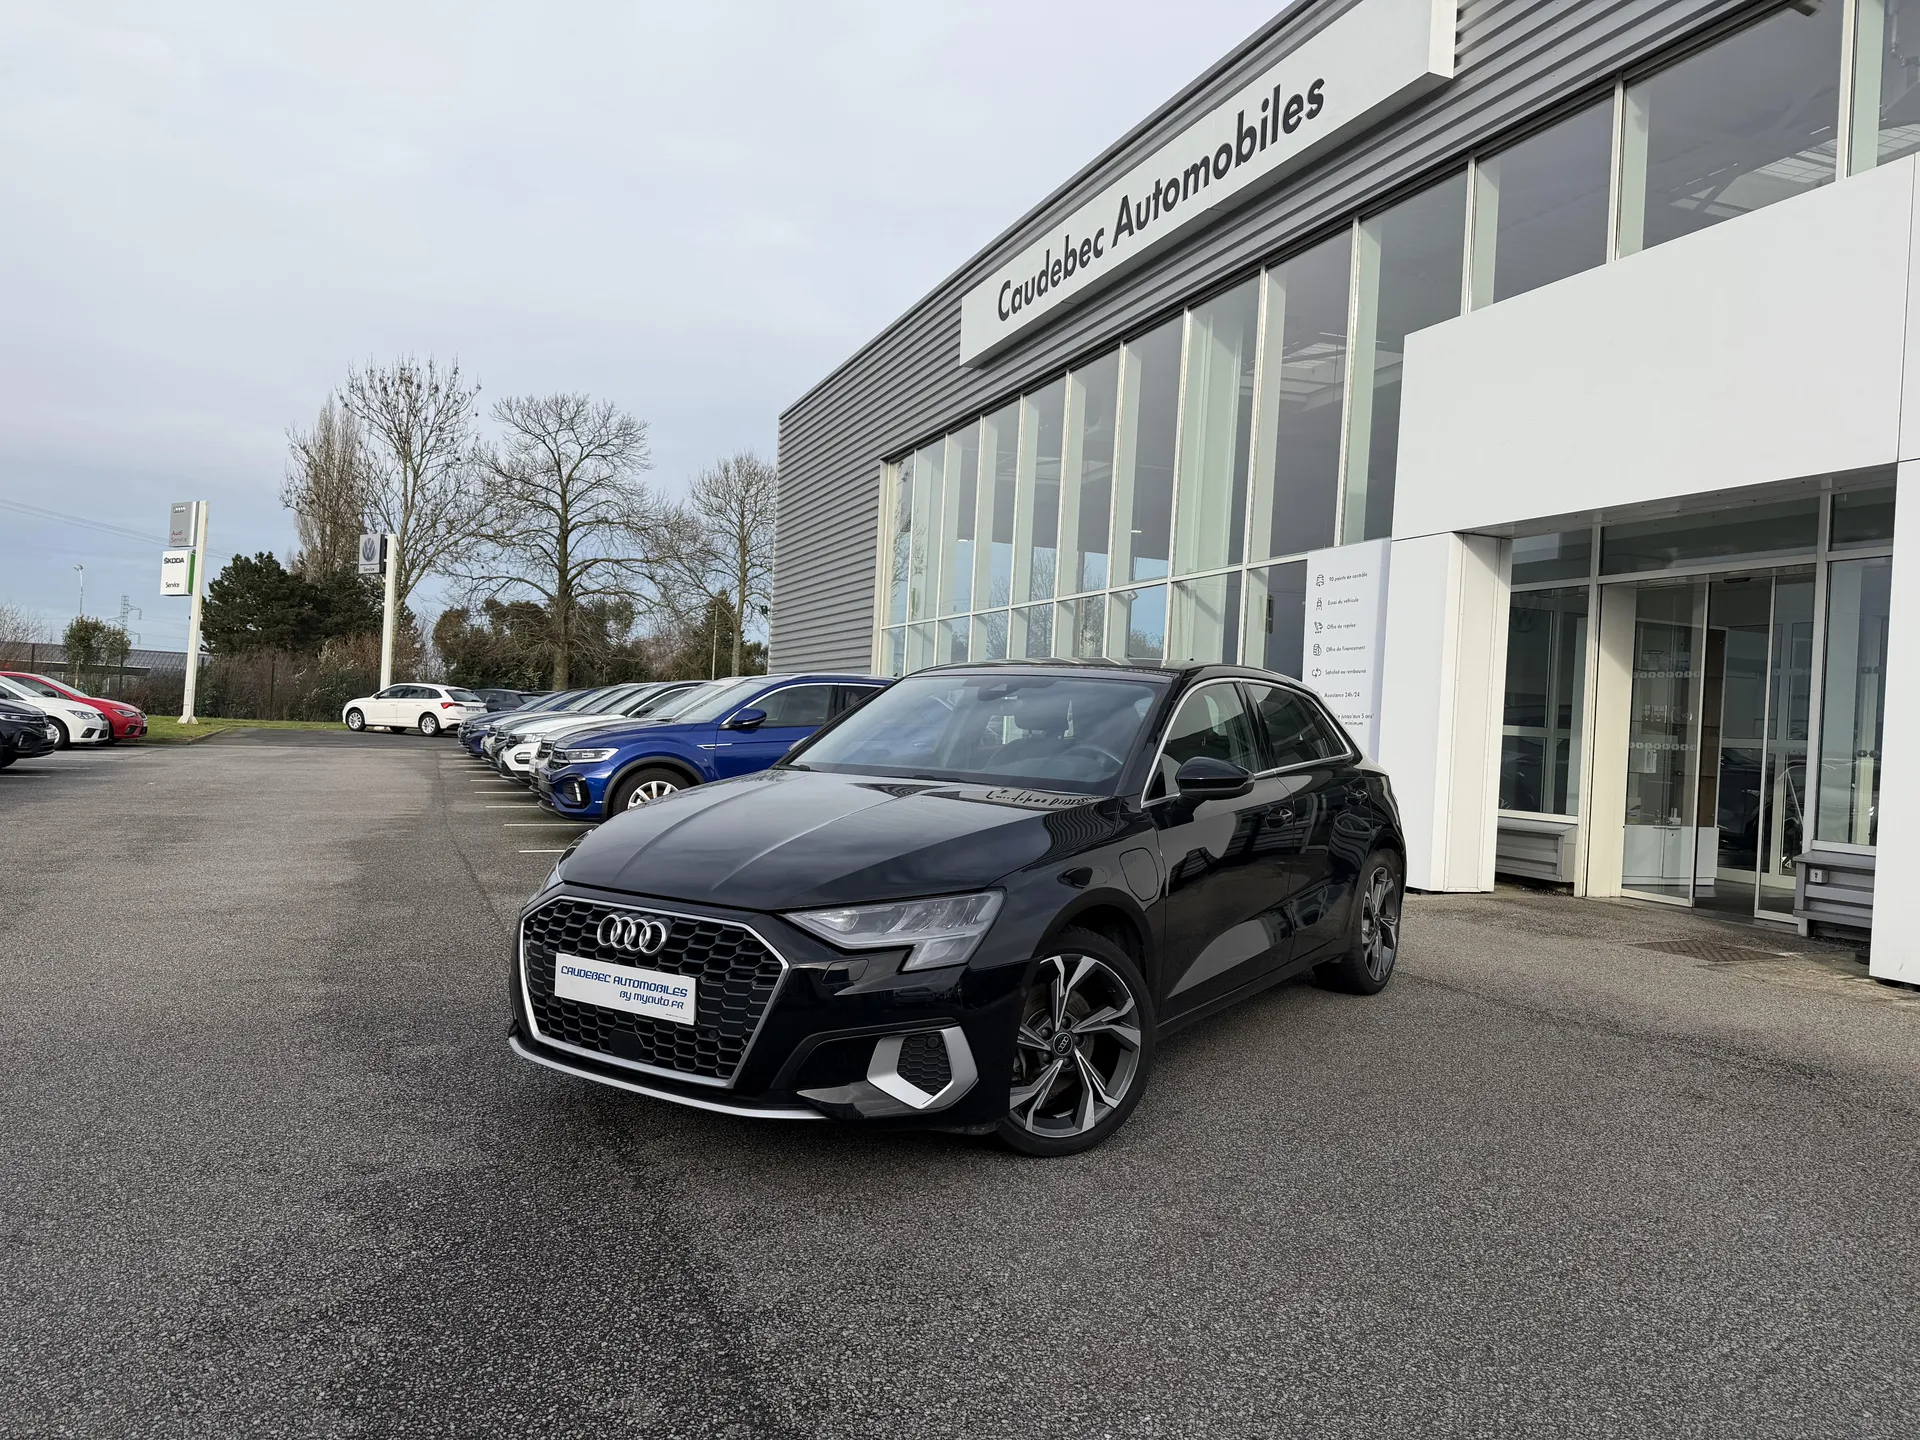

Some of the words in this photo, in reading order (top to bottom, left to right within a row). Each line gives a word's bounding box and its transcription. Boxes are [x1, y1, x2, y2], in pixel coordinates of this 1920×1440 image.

[998, 227, 1105, 322] Caudebec
[1111, 77, 1325, 249] Automobiles
[165, 581, 180, 589] Service
[560, 965, 611, 984] CAUDEBEC
[613, 975, 688, 998] AUTOMOBILES
